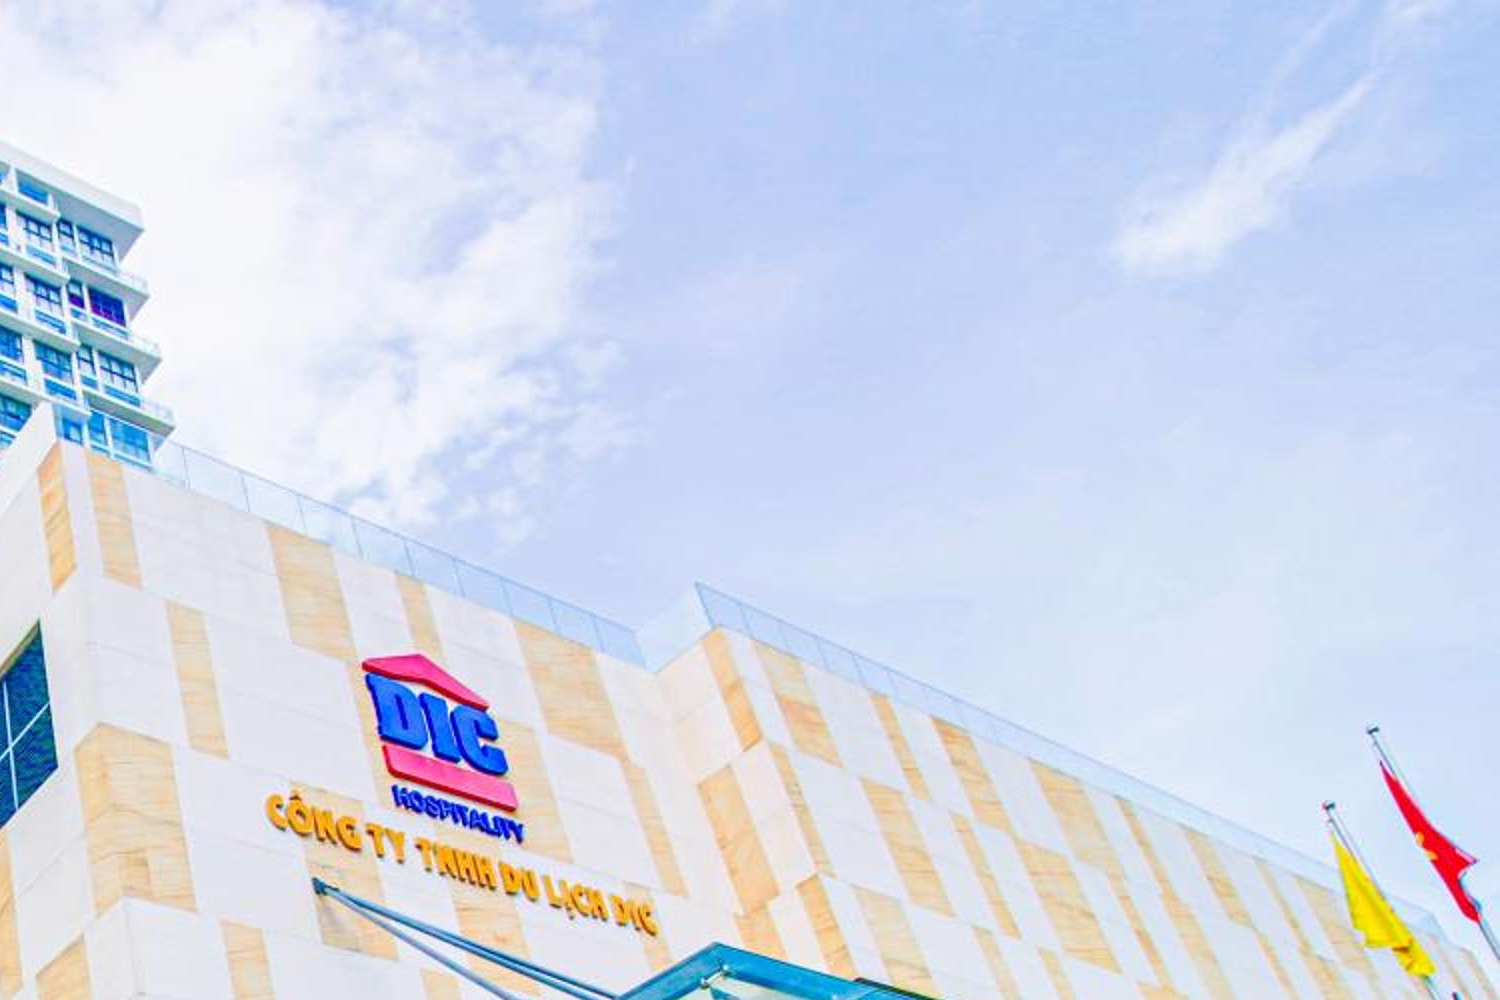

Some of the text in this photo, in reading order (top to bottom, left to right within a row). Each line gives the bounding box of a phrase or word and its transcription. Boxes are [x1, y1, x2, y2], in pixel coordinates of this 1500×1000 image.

[366, 673, 508, 776] DIC
[266, 792, 658, 936] CÔNG TY TNHH DU LỊCH DIC
[391, 785, 524, 843] HOSPITALITY
